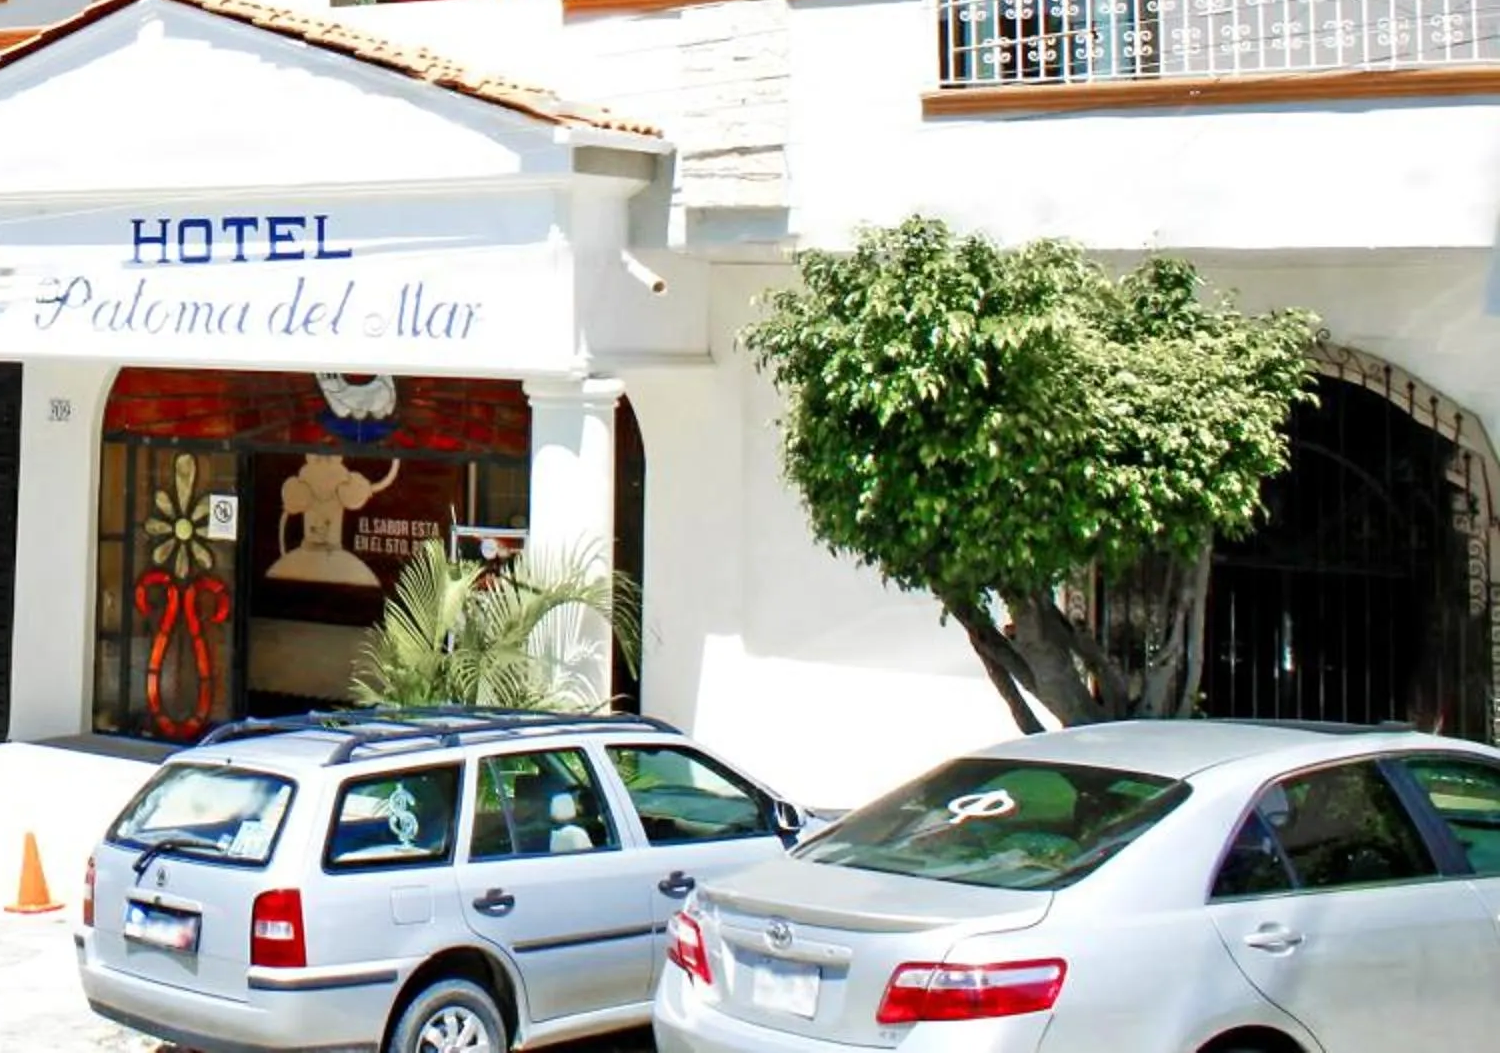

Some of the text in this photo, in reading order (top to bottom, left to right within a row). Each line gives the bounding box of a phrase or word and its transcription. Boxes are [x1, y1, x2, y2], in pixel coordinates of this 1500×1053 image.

[131, 215, 352, 264] HOTEL
[34, 276, 484, 340] Paloma del Mar
[354, 534, 369, 550] EN
[370, 536, 381, 552] EL
[358, 517, 439, 538] EL SABOR ESTA
